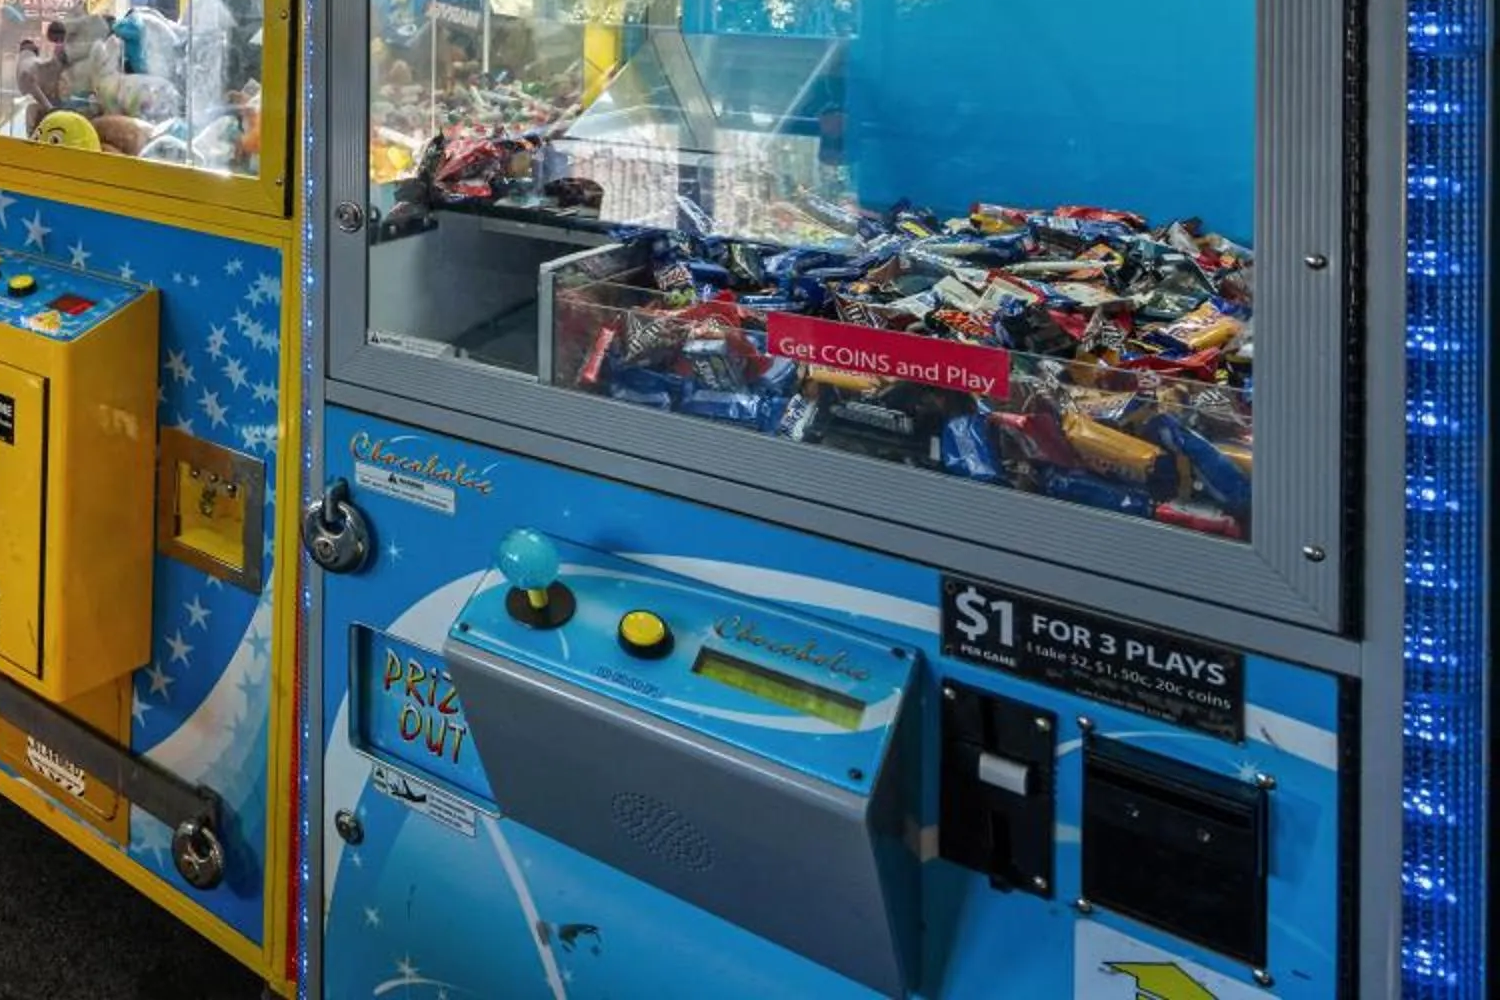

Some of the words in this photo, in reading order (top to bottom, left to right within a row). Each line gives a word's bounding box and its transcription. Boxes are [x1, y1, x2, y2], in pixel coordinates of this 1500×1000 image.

[779, 337, 817, 360] Get
[821, 345, 890, 374] COINS
[896, 360, 940, 382] and
[946, 365, 996, 394] Play
[954, 586, 1014, 647] $1
[1032, 613, 1092, 650] FOR
[1099, 633, 1117, 656] 3
[1125, 639, 1227, 686] PLAYS
[1035, 643, 1067, 662] take
[1155, 679, 1183, 697] 20c
[1186, 688, 1232, 711] coins
[400, 704, 468, 765] OUT
